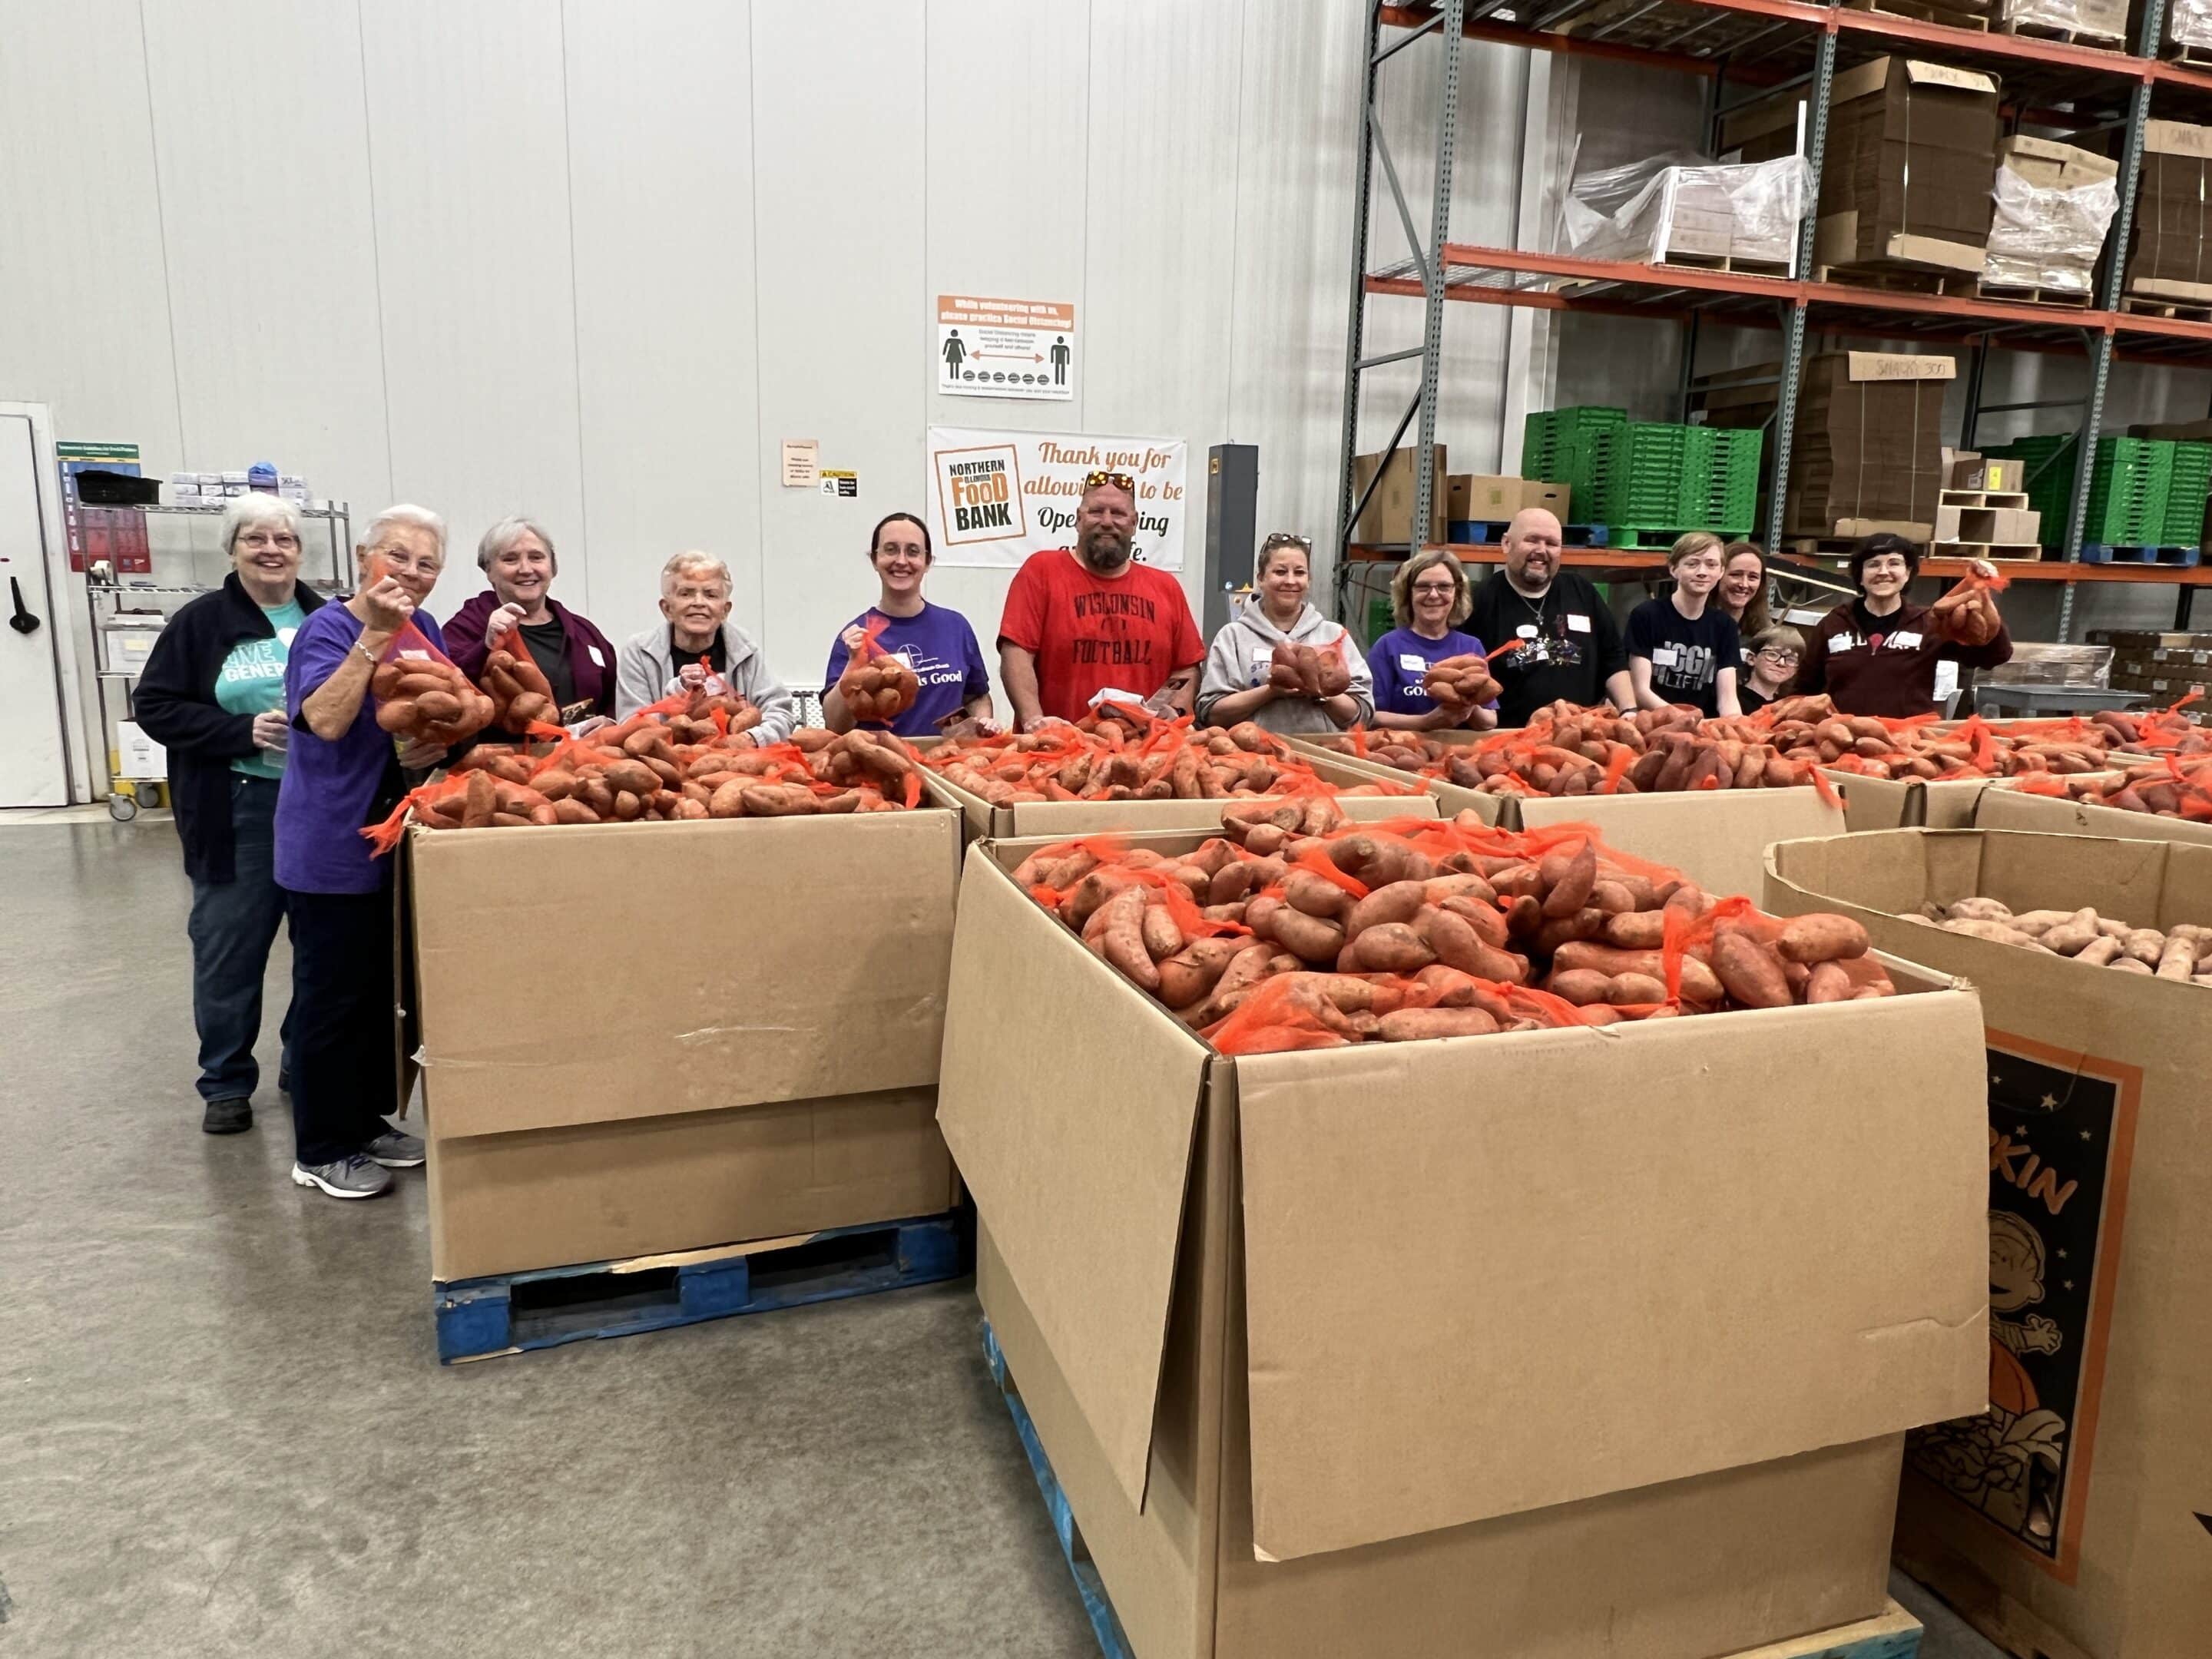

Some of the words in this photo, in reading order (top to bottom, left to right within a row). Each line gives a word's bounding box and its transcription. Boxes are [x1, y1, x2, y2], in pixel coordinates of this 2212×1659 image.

[949, 459, 1005, 476] NORTHERN
[1038, 442, 1100, 465] Thank
[1106, 452, 1140, 472] you
[1139, 448, 1171, 474] for
[1140, 482, 1157, 499] to
[1163, 481, 1183, 500] be
[955, 502, 1012, 531] BANK
[1074, 592, 1155, 624] WISCONSIN
[1072, 639, 1152, 665] FOOTBALL
[930, 670, 962, 684] Good
